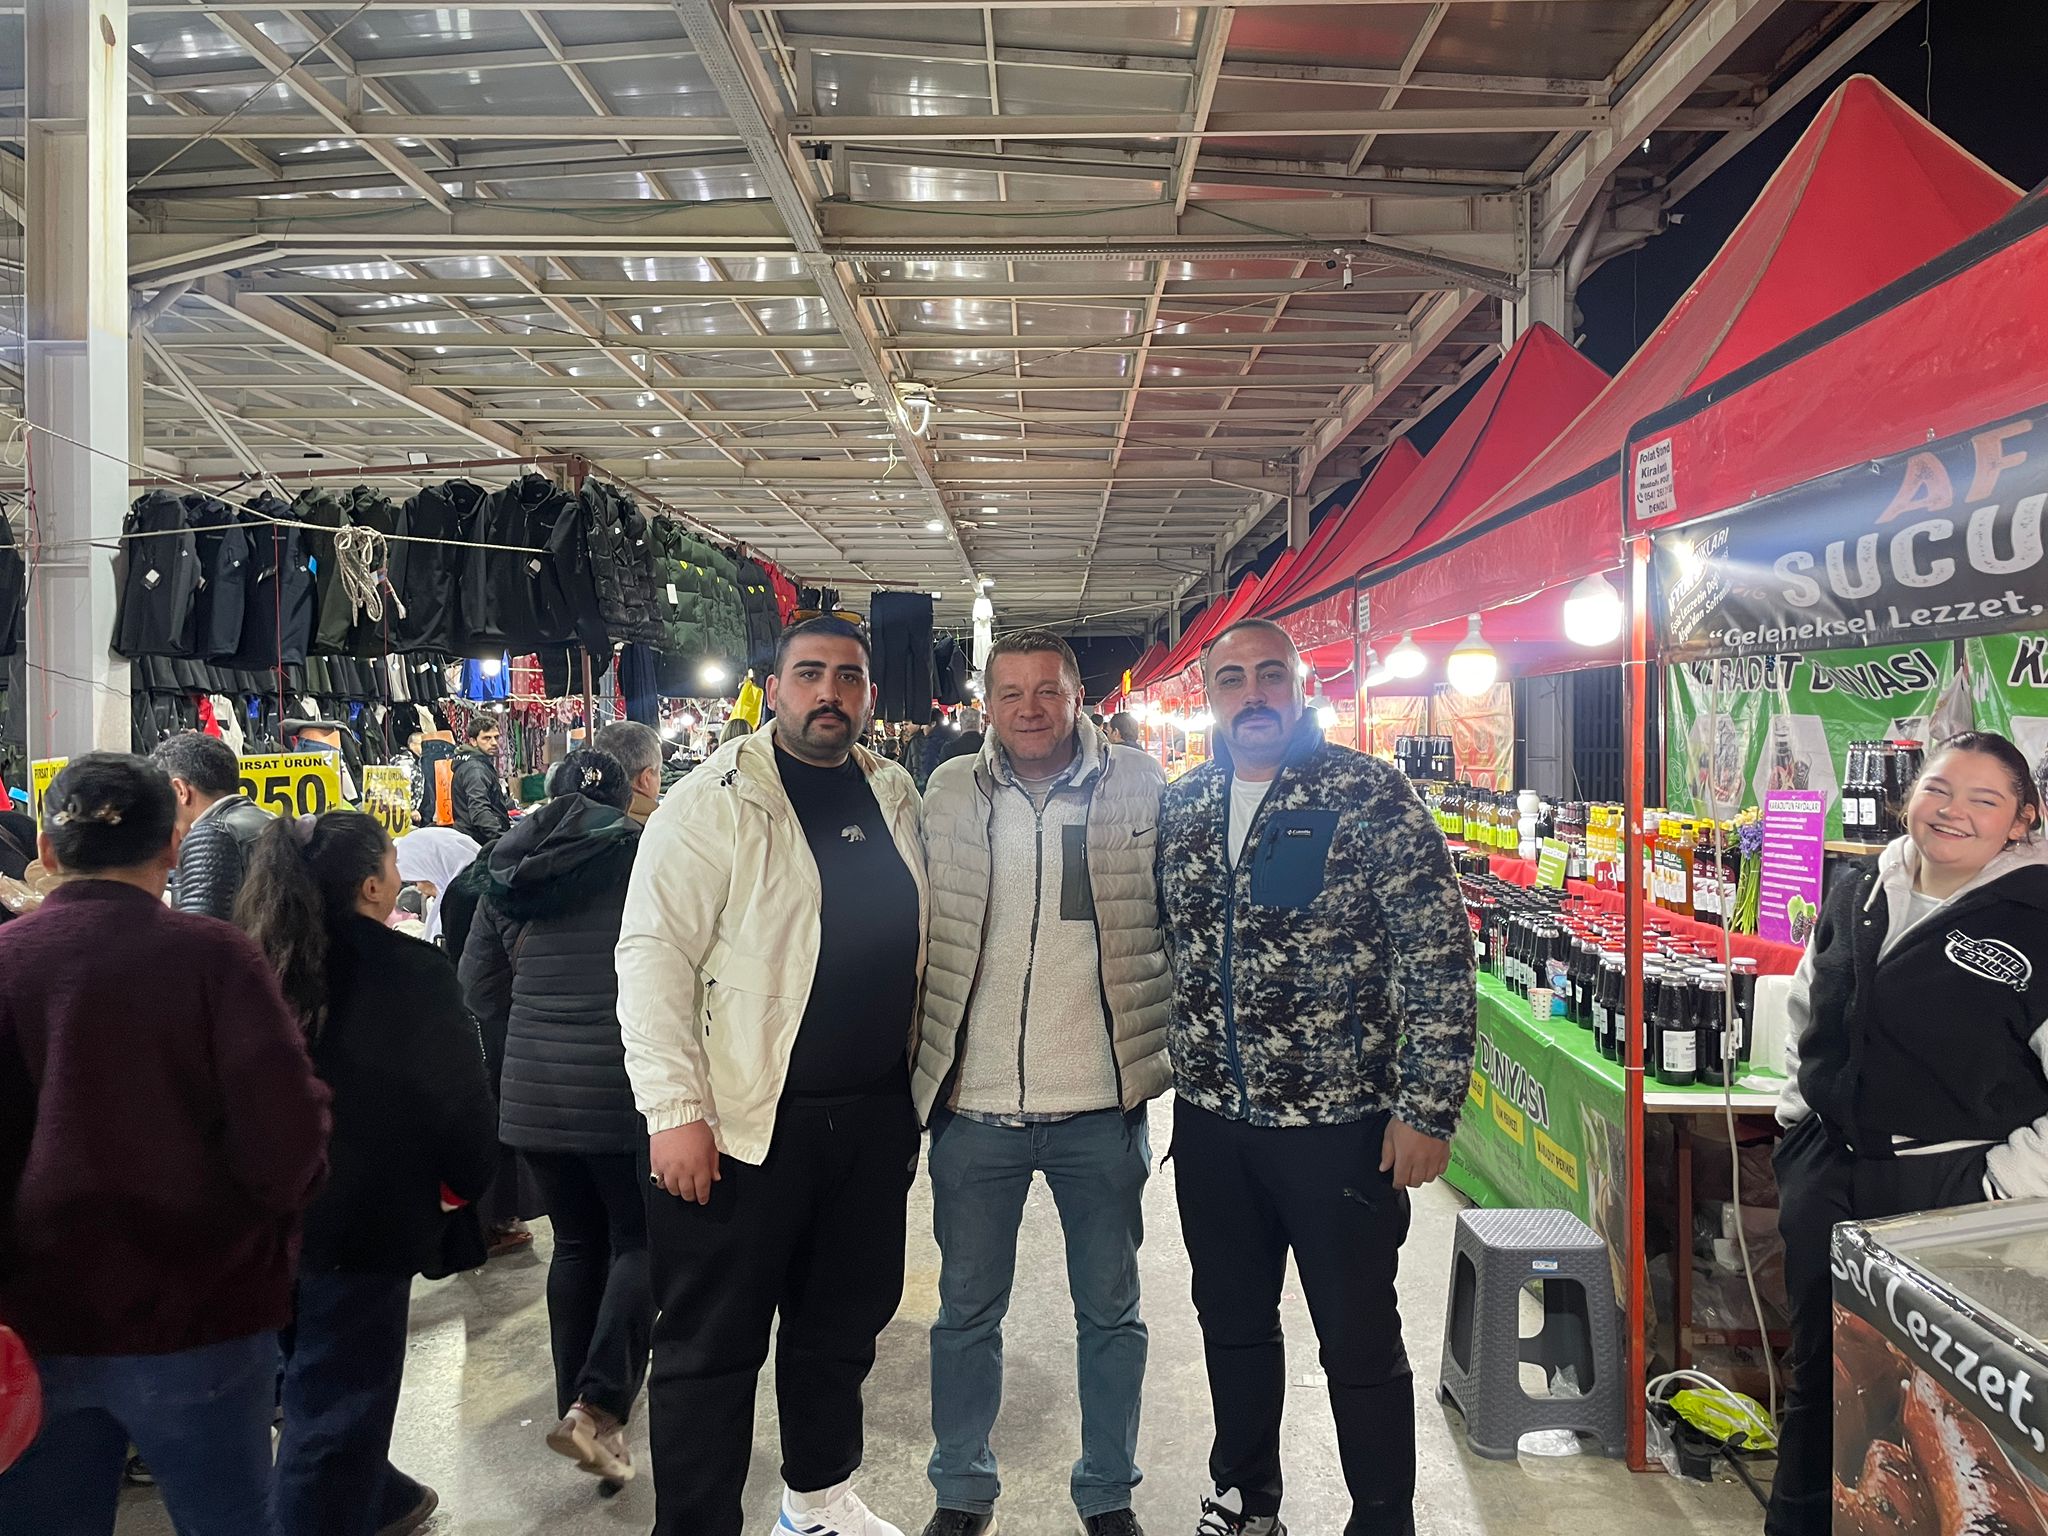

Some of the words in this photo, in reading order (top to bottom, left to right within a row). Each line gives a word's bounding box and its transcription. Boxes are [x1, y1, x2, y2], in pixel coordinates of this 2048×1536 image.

[1773, 493, 2048, 608] SUCU
[1888, 590, 2044, 630] Lezzet,
[238, 758, 279, 771] IRSAT
[1886, 1276, 2045, 1454] Lezzet,
